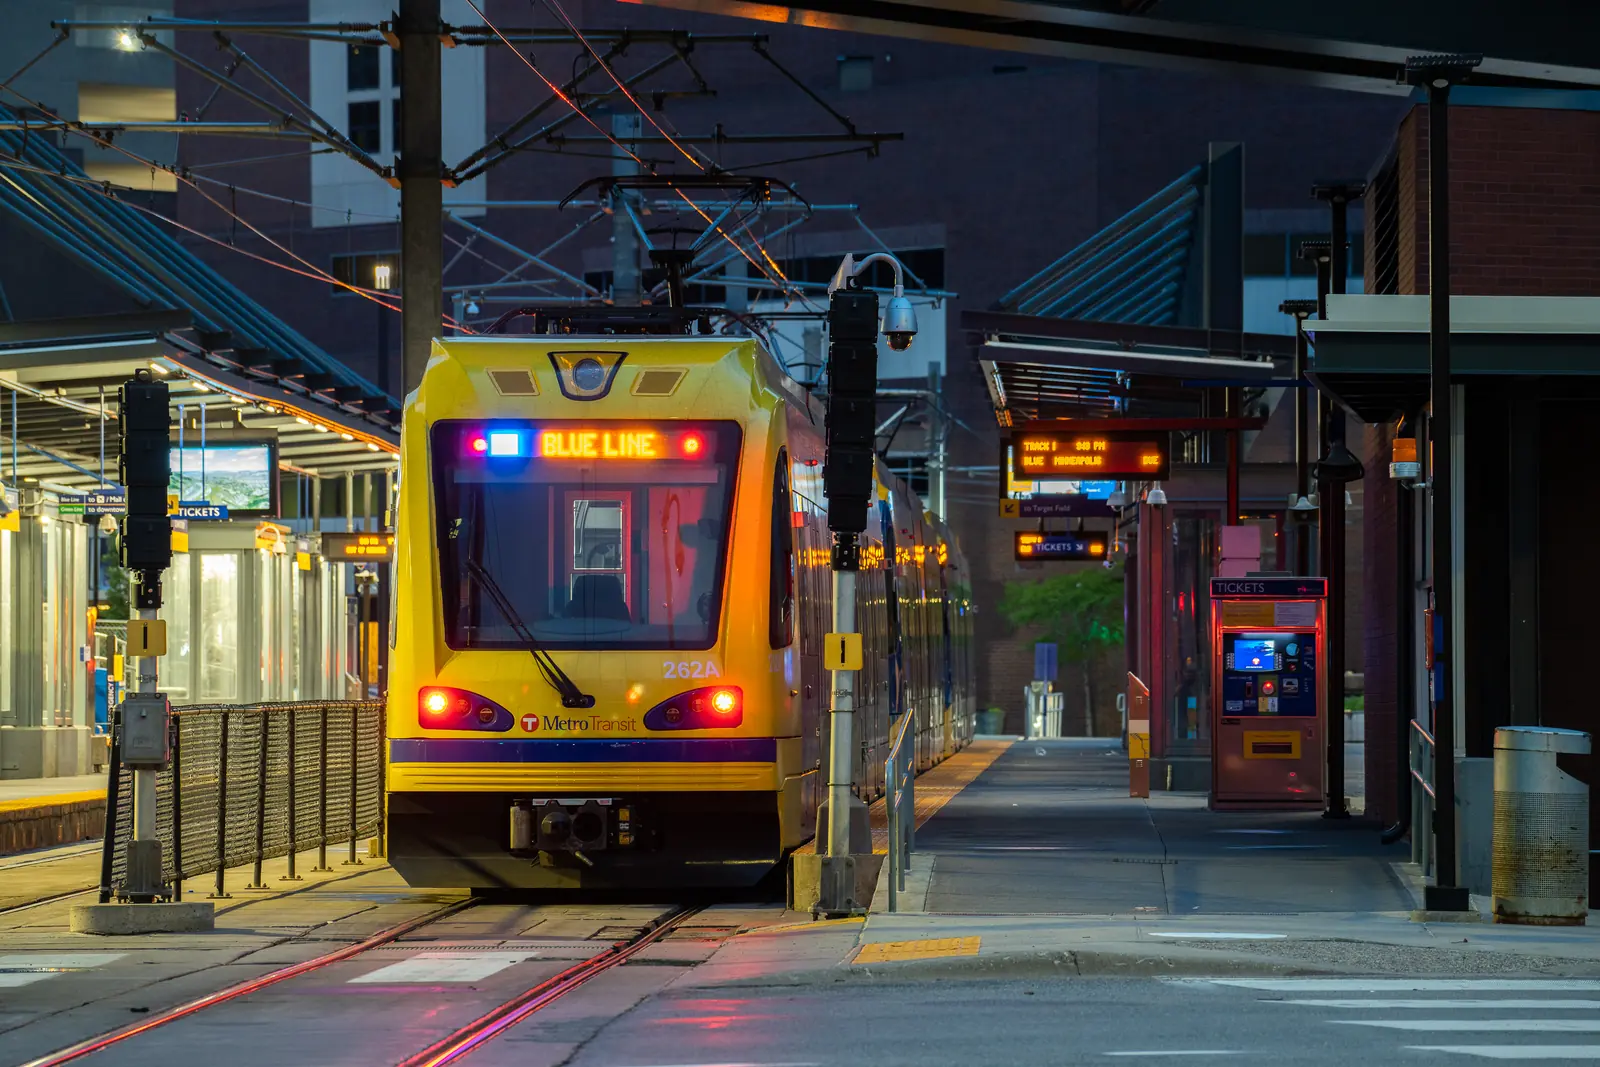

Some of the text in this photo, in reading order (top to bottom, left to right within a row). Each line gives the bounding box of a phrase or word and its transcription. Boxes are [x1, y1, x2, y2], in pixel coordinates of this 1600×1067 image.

[543, 432, 656, 457] BLUE LINE
[178, 507, 220, 517] TICKETS
[1032, 504, 1054, 513] Target
[1055, 504, 1071, 512] Field
[1035, 543, 1072, 552] TICKETS
[1215, 582, 1265, 593] TICKETS
[663, 660, 721, 679] 262A
